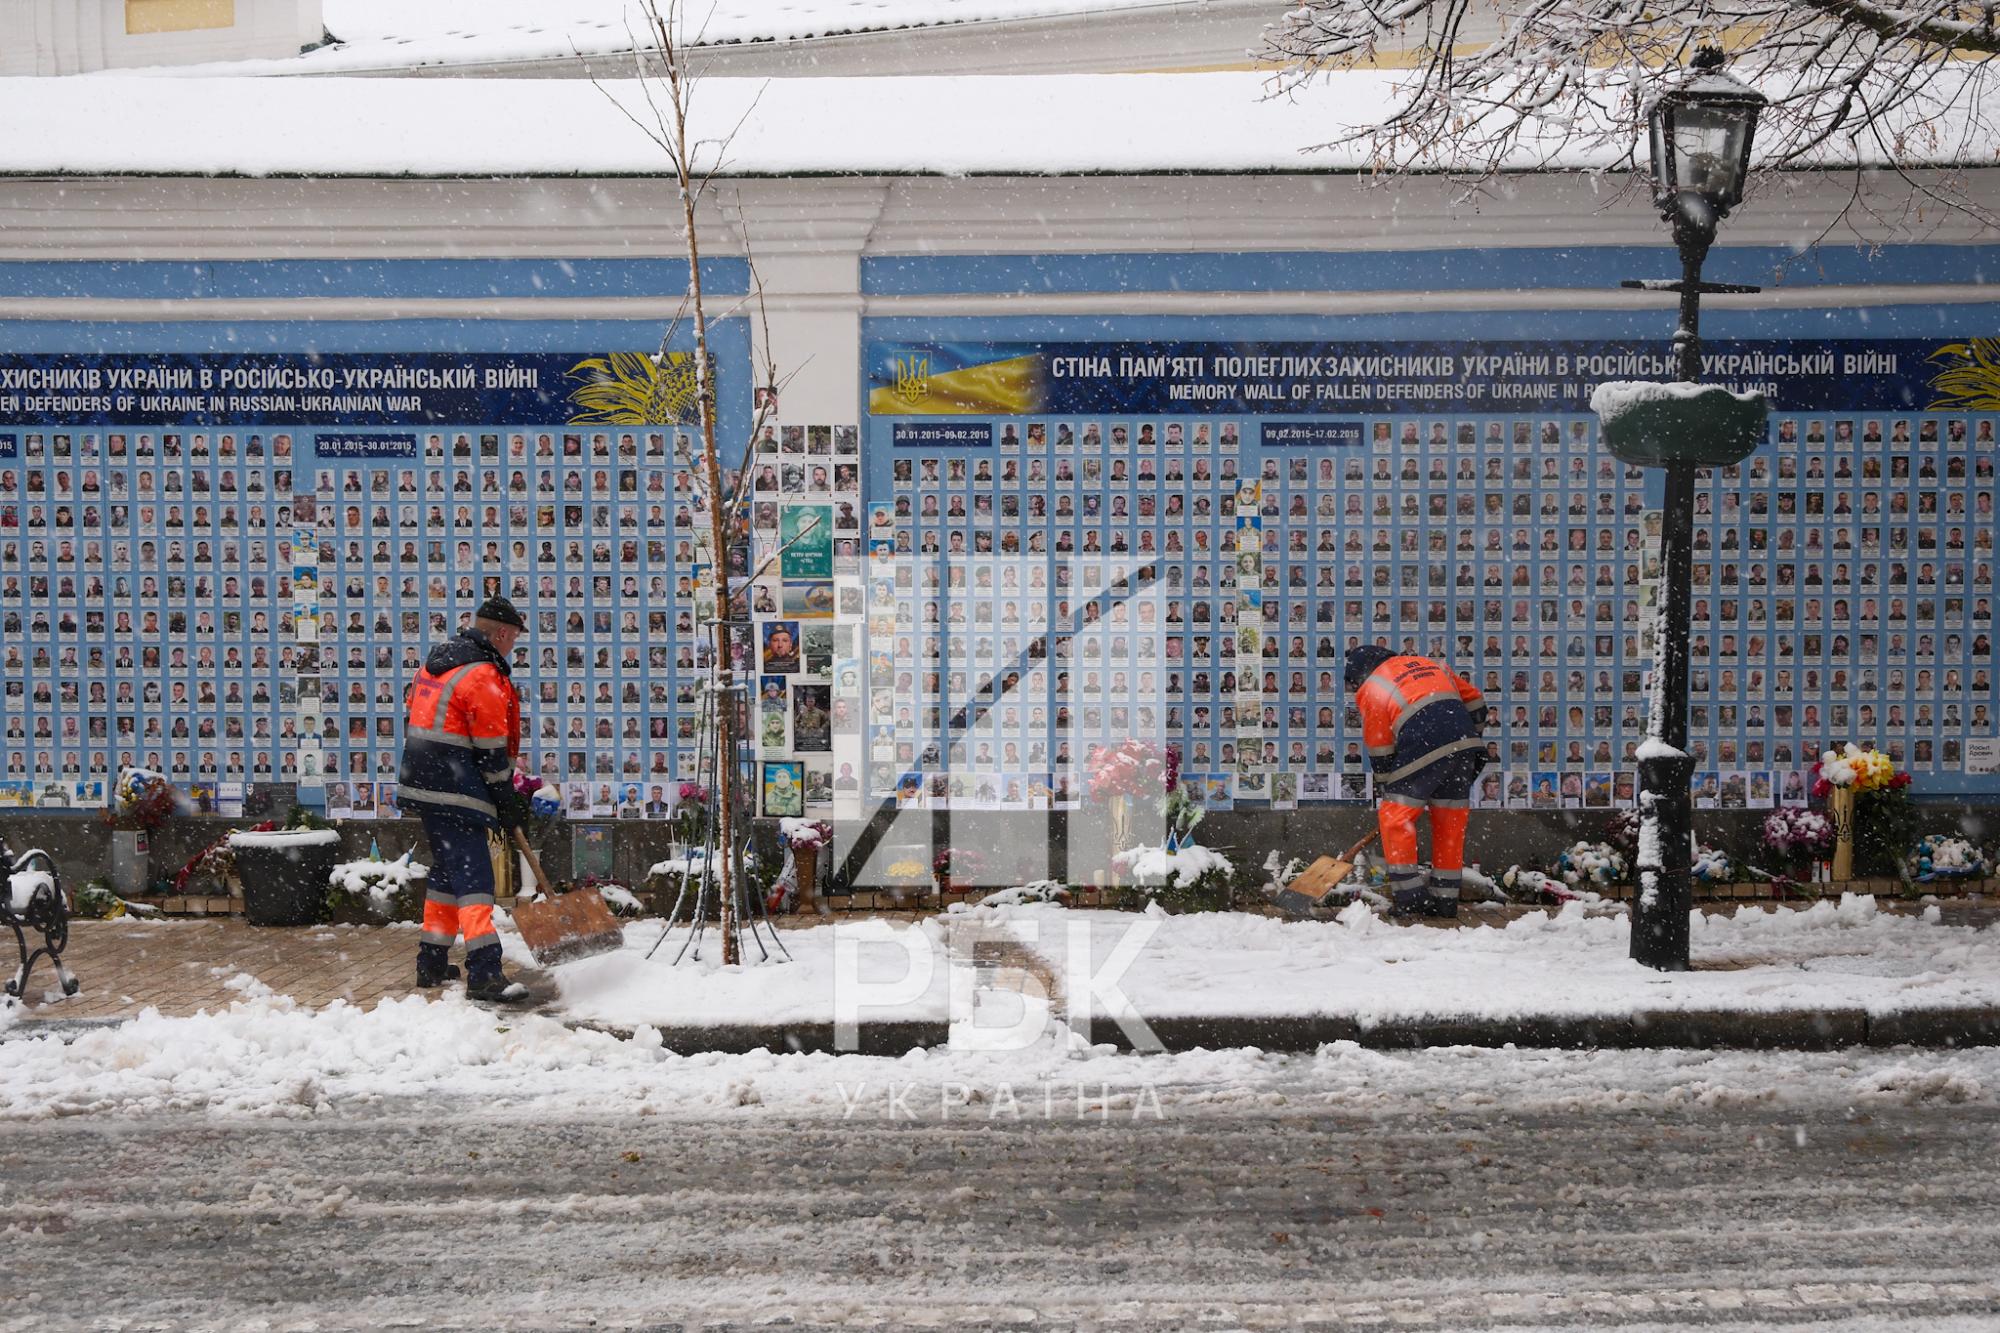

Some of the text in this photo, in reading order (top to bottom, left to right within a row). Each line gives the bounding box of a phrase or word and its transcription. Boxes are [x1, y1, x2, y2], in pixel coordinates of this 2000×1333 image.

[1052, 356, 1112, 377] СТІНА
[1214, 356, 1321, 377] ПОЛЕГЛИХ
[1325, 356, 1454, 377] ЗАХИСНИКІВ
[1462, 352, 1549, 377] УКРАЇНИ
[1556, 355, 1569, 375] В
[1844, 353, 1897, 374] ВІЙНІ
[0, 362, 538, 389] ХИСНИКІВ УКРАЇНИ В РОСІЙСЬКО-УКРАЇНСЬКІЙ ВІЙНІ
[1169, 383, 1237, 399] MEMORY
[1244, 383, 1286, 399] WALL
[1292, 383, 1311, 399] OF
[1316, 383, 1371, 399] FALLEN
[1376, 383, 1464, 399] DEFENDERS
[1467, 383, 1485, 399] OF
[1491, 383, 1557, 399] UKRAINE
[1563, 382, 1578, 398] IN
[24, 396, 111, 412] DEFENDERS
[117, 396, 135, 412] OF
[140, 396, 205, 412] UKRAINE
[209, 396, 225, 412] IN
[230, 396, 382, 412] RUSSIAN-UKRAINIAN
[387, 396, 422, 412] WAR
